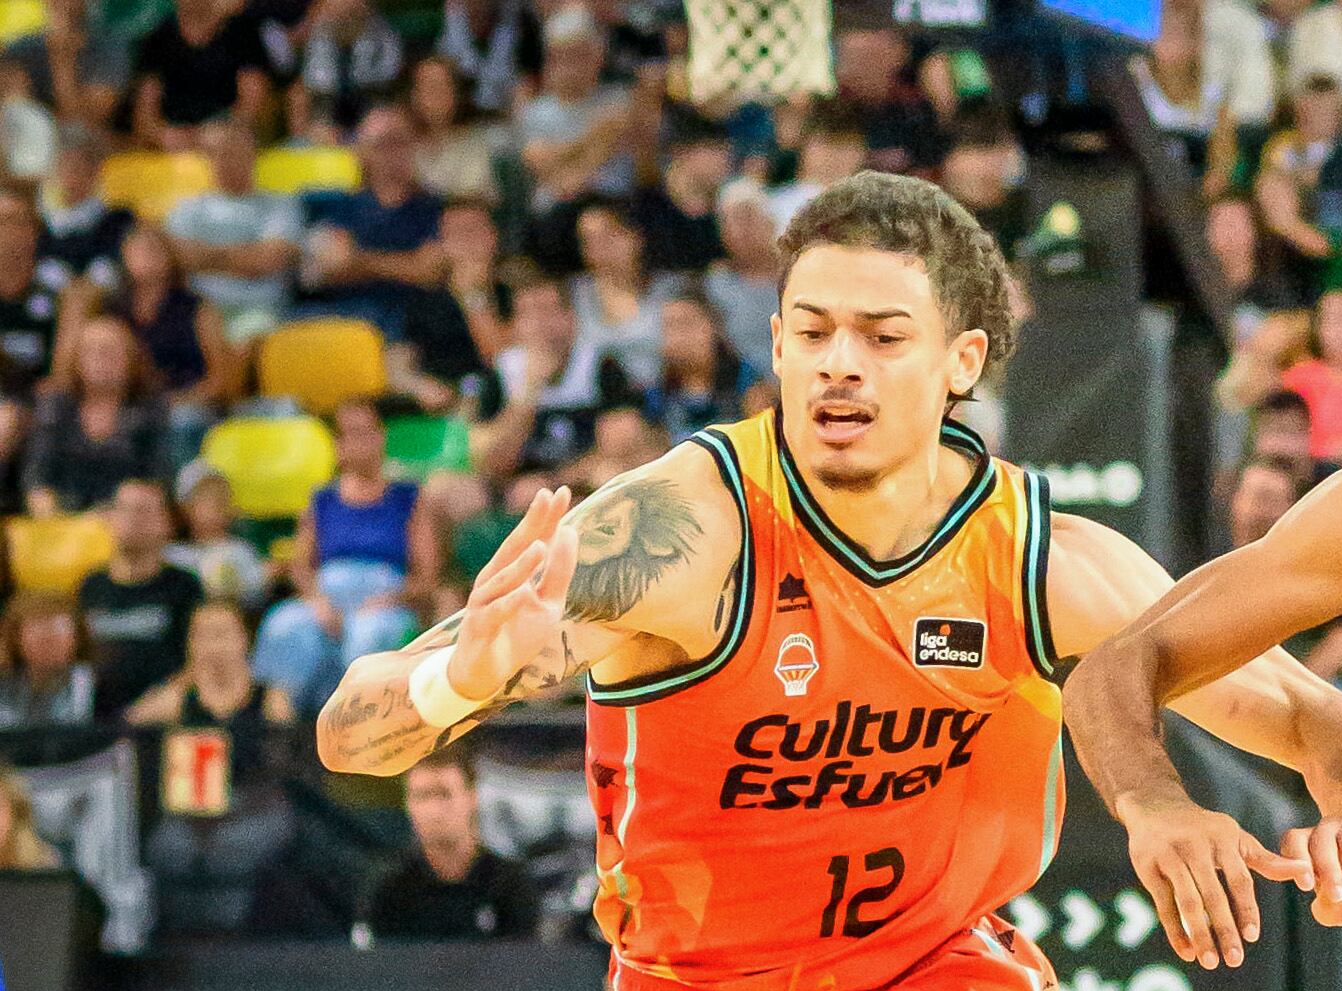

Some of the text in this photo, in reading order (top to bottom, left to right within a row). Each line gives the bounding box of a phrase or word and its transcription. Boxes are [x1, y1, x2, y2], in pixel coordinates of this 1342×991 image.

[920, 632, 948, 648] liga
[919, 647, 979, 663] endesa
[820, 846, 906, 938] 12
